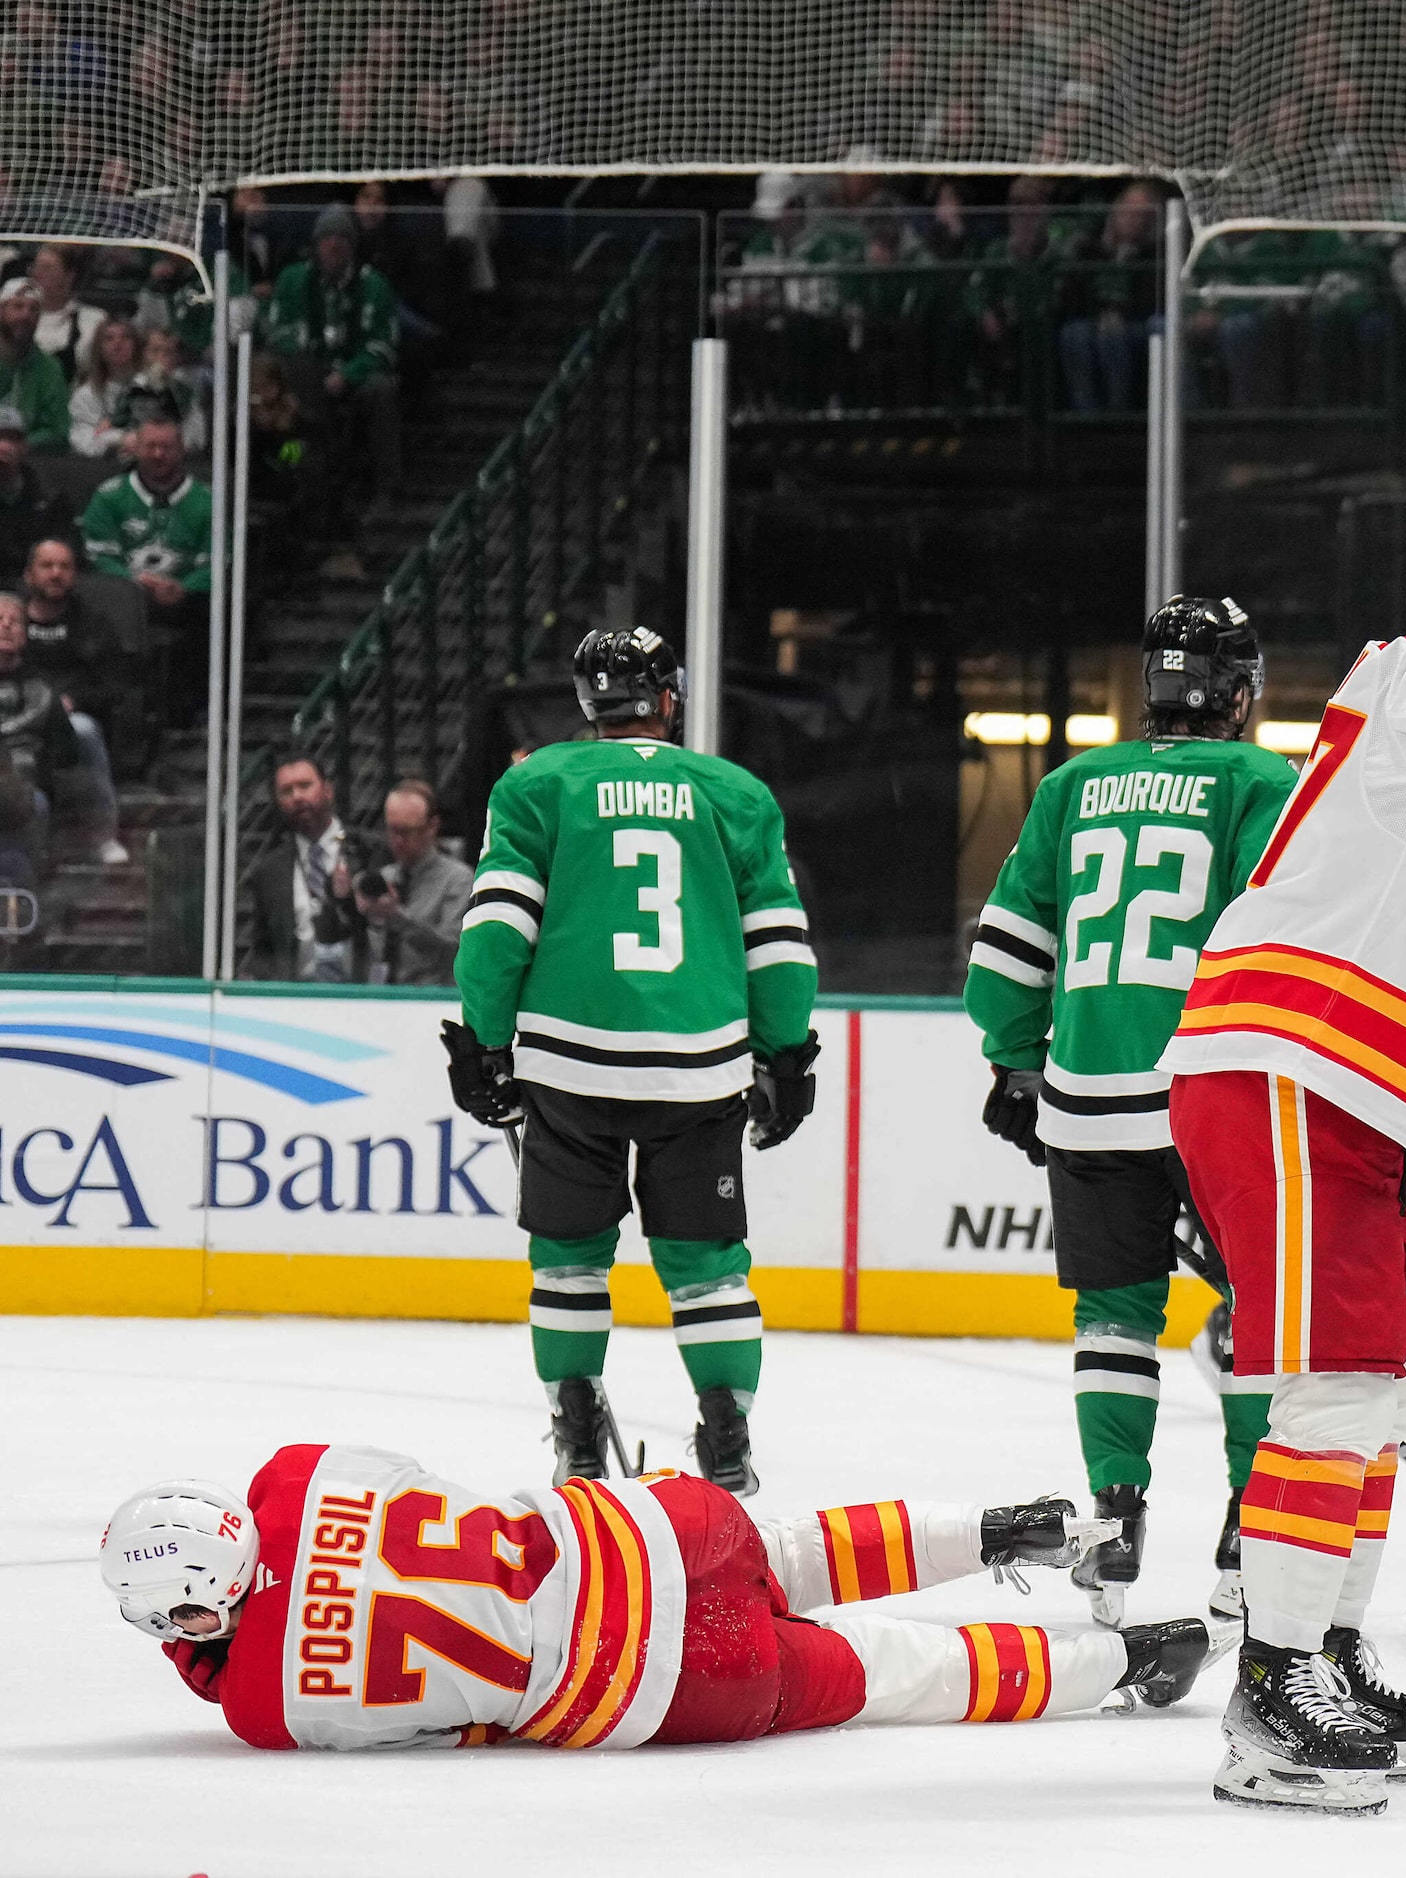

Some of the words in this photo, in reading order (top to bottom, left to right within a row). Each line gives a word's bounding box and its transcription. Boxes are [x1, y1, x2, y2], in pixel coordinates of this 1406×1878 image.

[597, 672, 609, 691] 3
[1162, 650, 1185, 671] 22
[596, 781, 695, 820] DUMBA
[1079, 771, 1217, 819] BOURQUE
[613, 828, 684, 974] 3
[1063, 825, 1215, 993] 22
[192, 1113, 506, 1219] Bank
[217, 1511, 243, 1543] 76
[123, 1542, 179, 1563] TELUS
[298, 1490, 377, 1697] POSPISIL
[361, 1487, 561, 1708] 76
